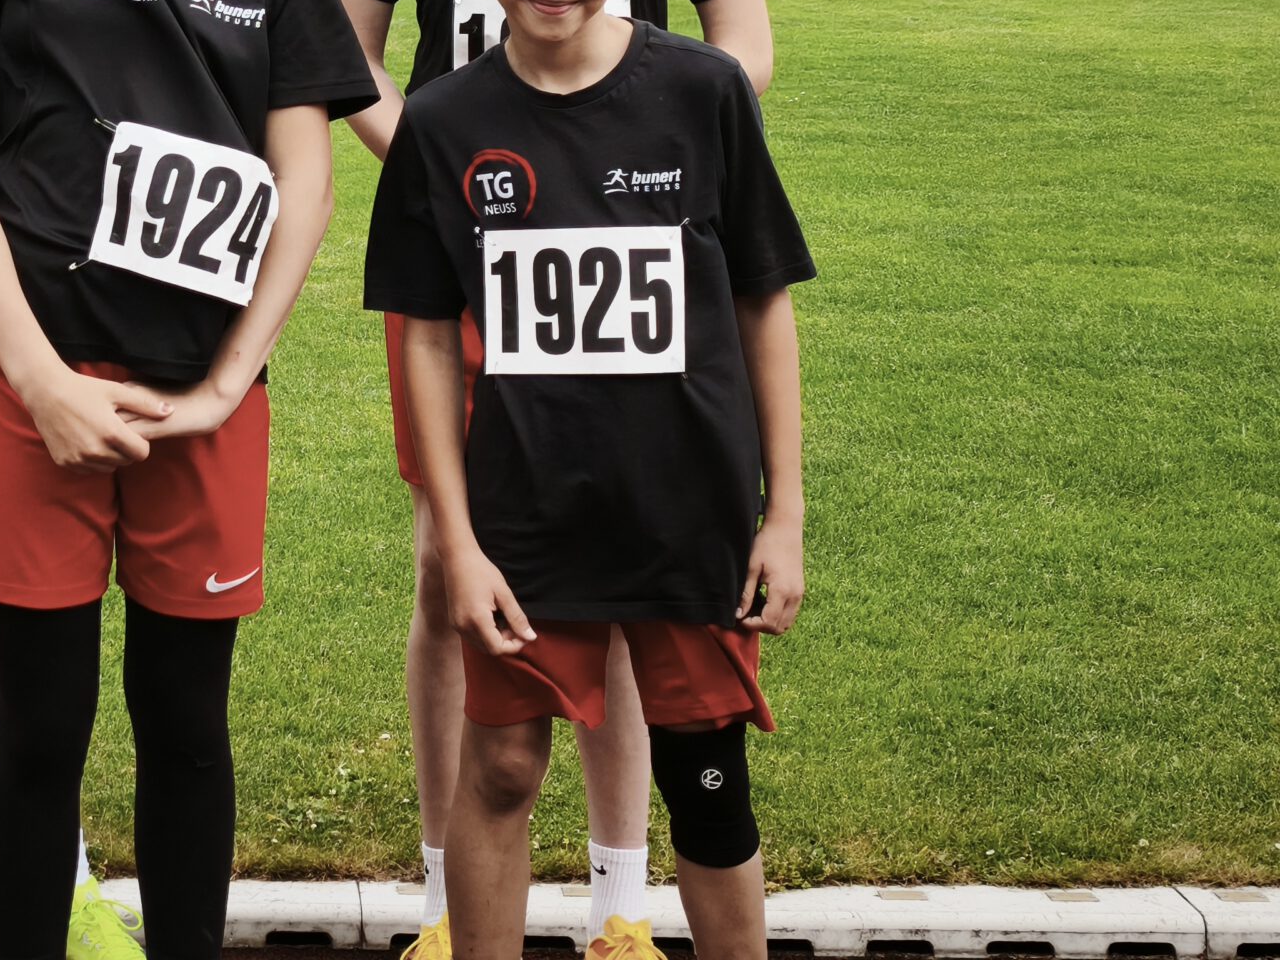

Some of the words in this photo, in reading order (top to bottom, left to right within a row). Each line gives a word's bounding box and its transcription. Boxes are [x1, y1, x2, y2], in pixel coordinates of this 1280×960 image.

[214, 0, 266, 21] bunert
[215, 11, 262, 29] NEUSS
[476, 171, 514, 201] TG
[631, 168, 682, 185] bunert
[633, 182, 681, 193] NEUSS
[109, 144, 273, 284] 1924
[484, 202, 517, 216] NEUSS
[491, 246, 673, 355] 1925
